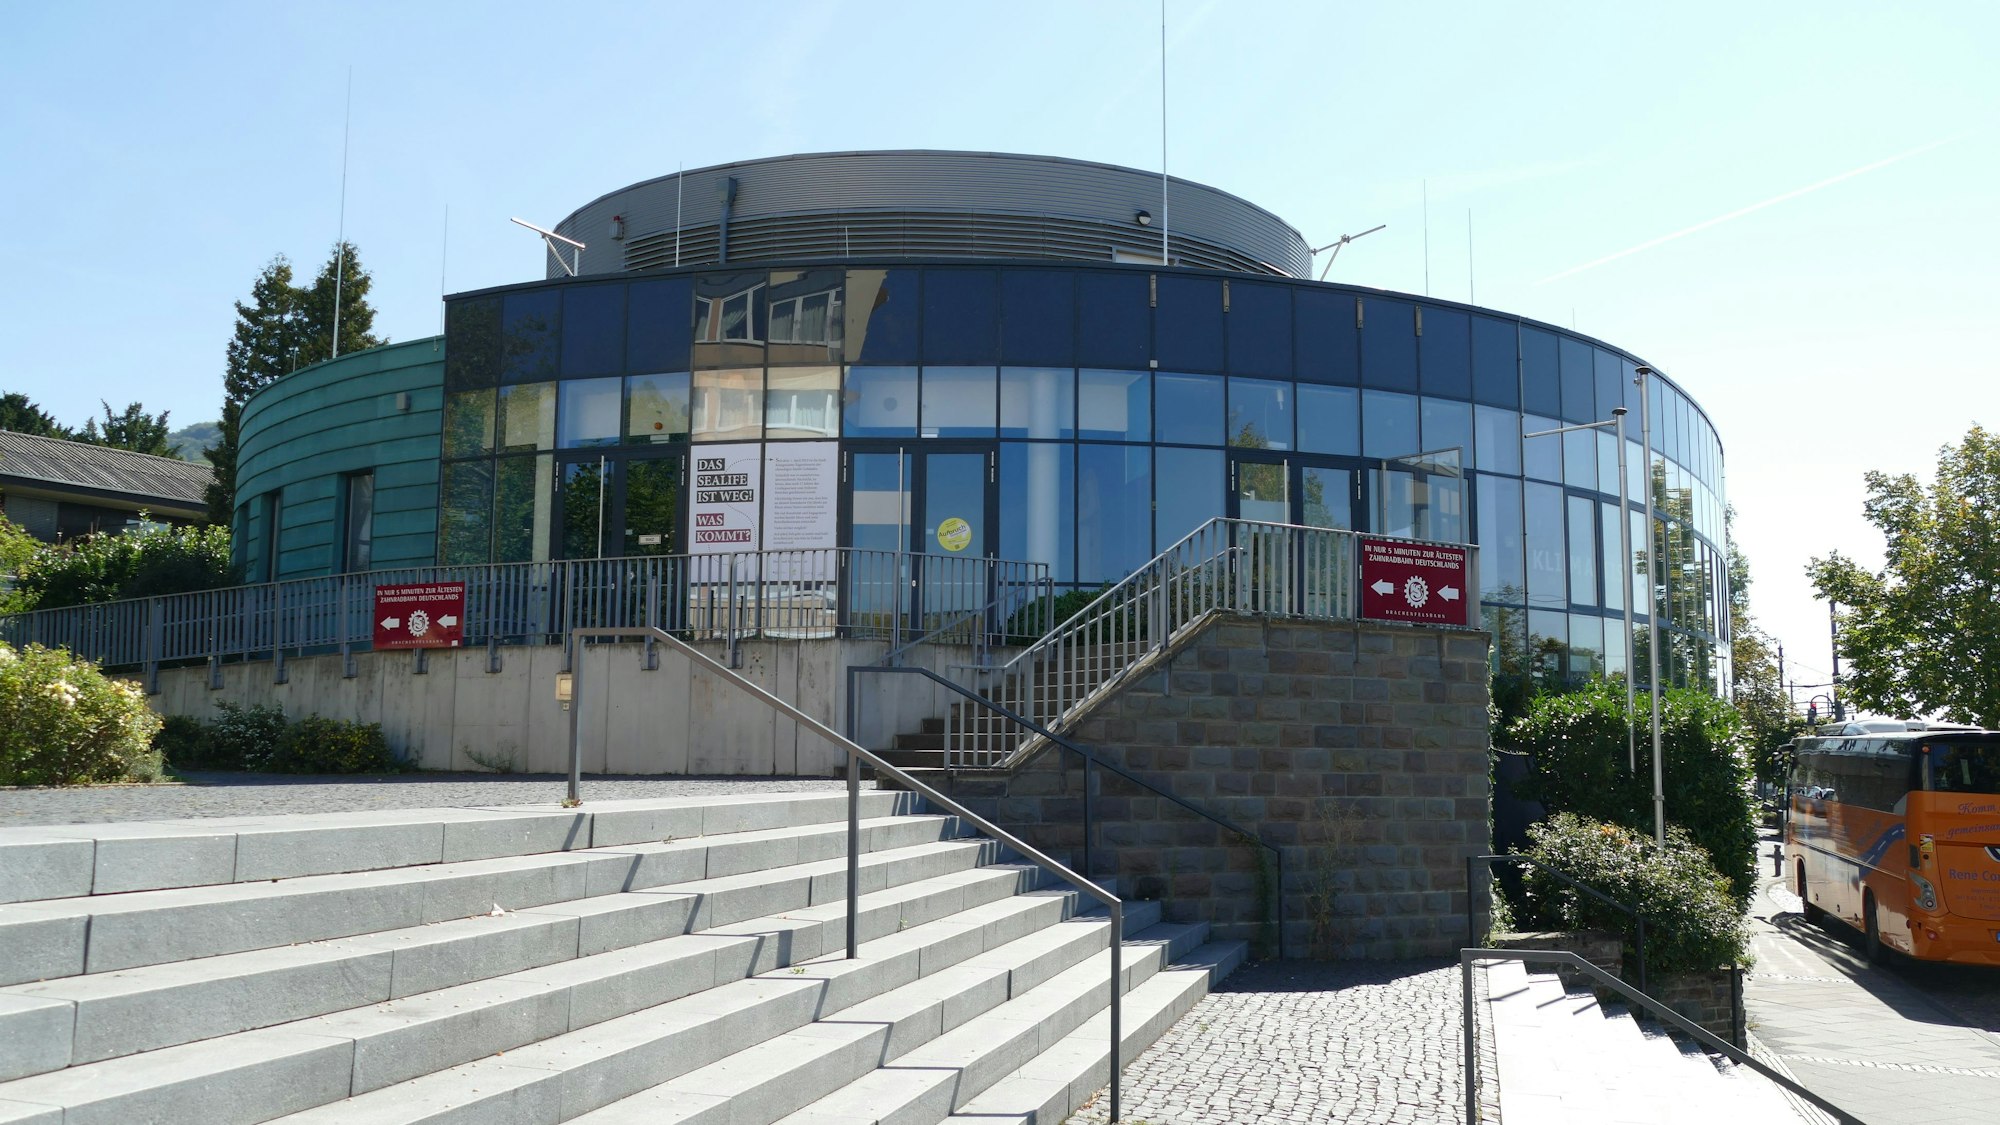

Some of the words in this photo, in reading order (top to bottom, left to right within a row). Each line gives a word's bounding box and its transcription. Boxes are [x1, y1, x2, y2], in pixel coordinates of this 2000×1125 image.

[698, 459, 723, 471] DAS
[697, 475, 747, 486] SEALIFE
[697, 491, 718, 503] IST
[719, 490, 753, 502] WEG!
[696, 515, 723, 526] WAS
[696, 530, 751, 542] KOMMT?
[1364, 544, 1372, 552] IN
[1373, 545, 1386, 554] NUR
[1394, 548, 1421, 557] MINUTEN
[1423, 551, 1434, 559] ZUR
[1436, 550, 1463, 562] ÄLTESTEN
[1369, 554, 1414, 565] ZAHNRADBAHN
[1415, 559, 1460, 570] DEUTSCHLANDS
[384, 588, 395, 596] NUR
[401, 587, 424, 595] MINUTEN
[437, 586, 463, 594] ÄLTESTEN
[380, 595, 417, 603] ZAHNRADBAHN
[418, 594, 459, 602] DEUTSCHLANDS
